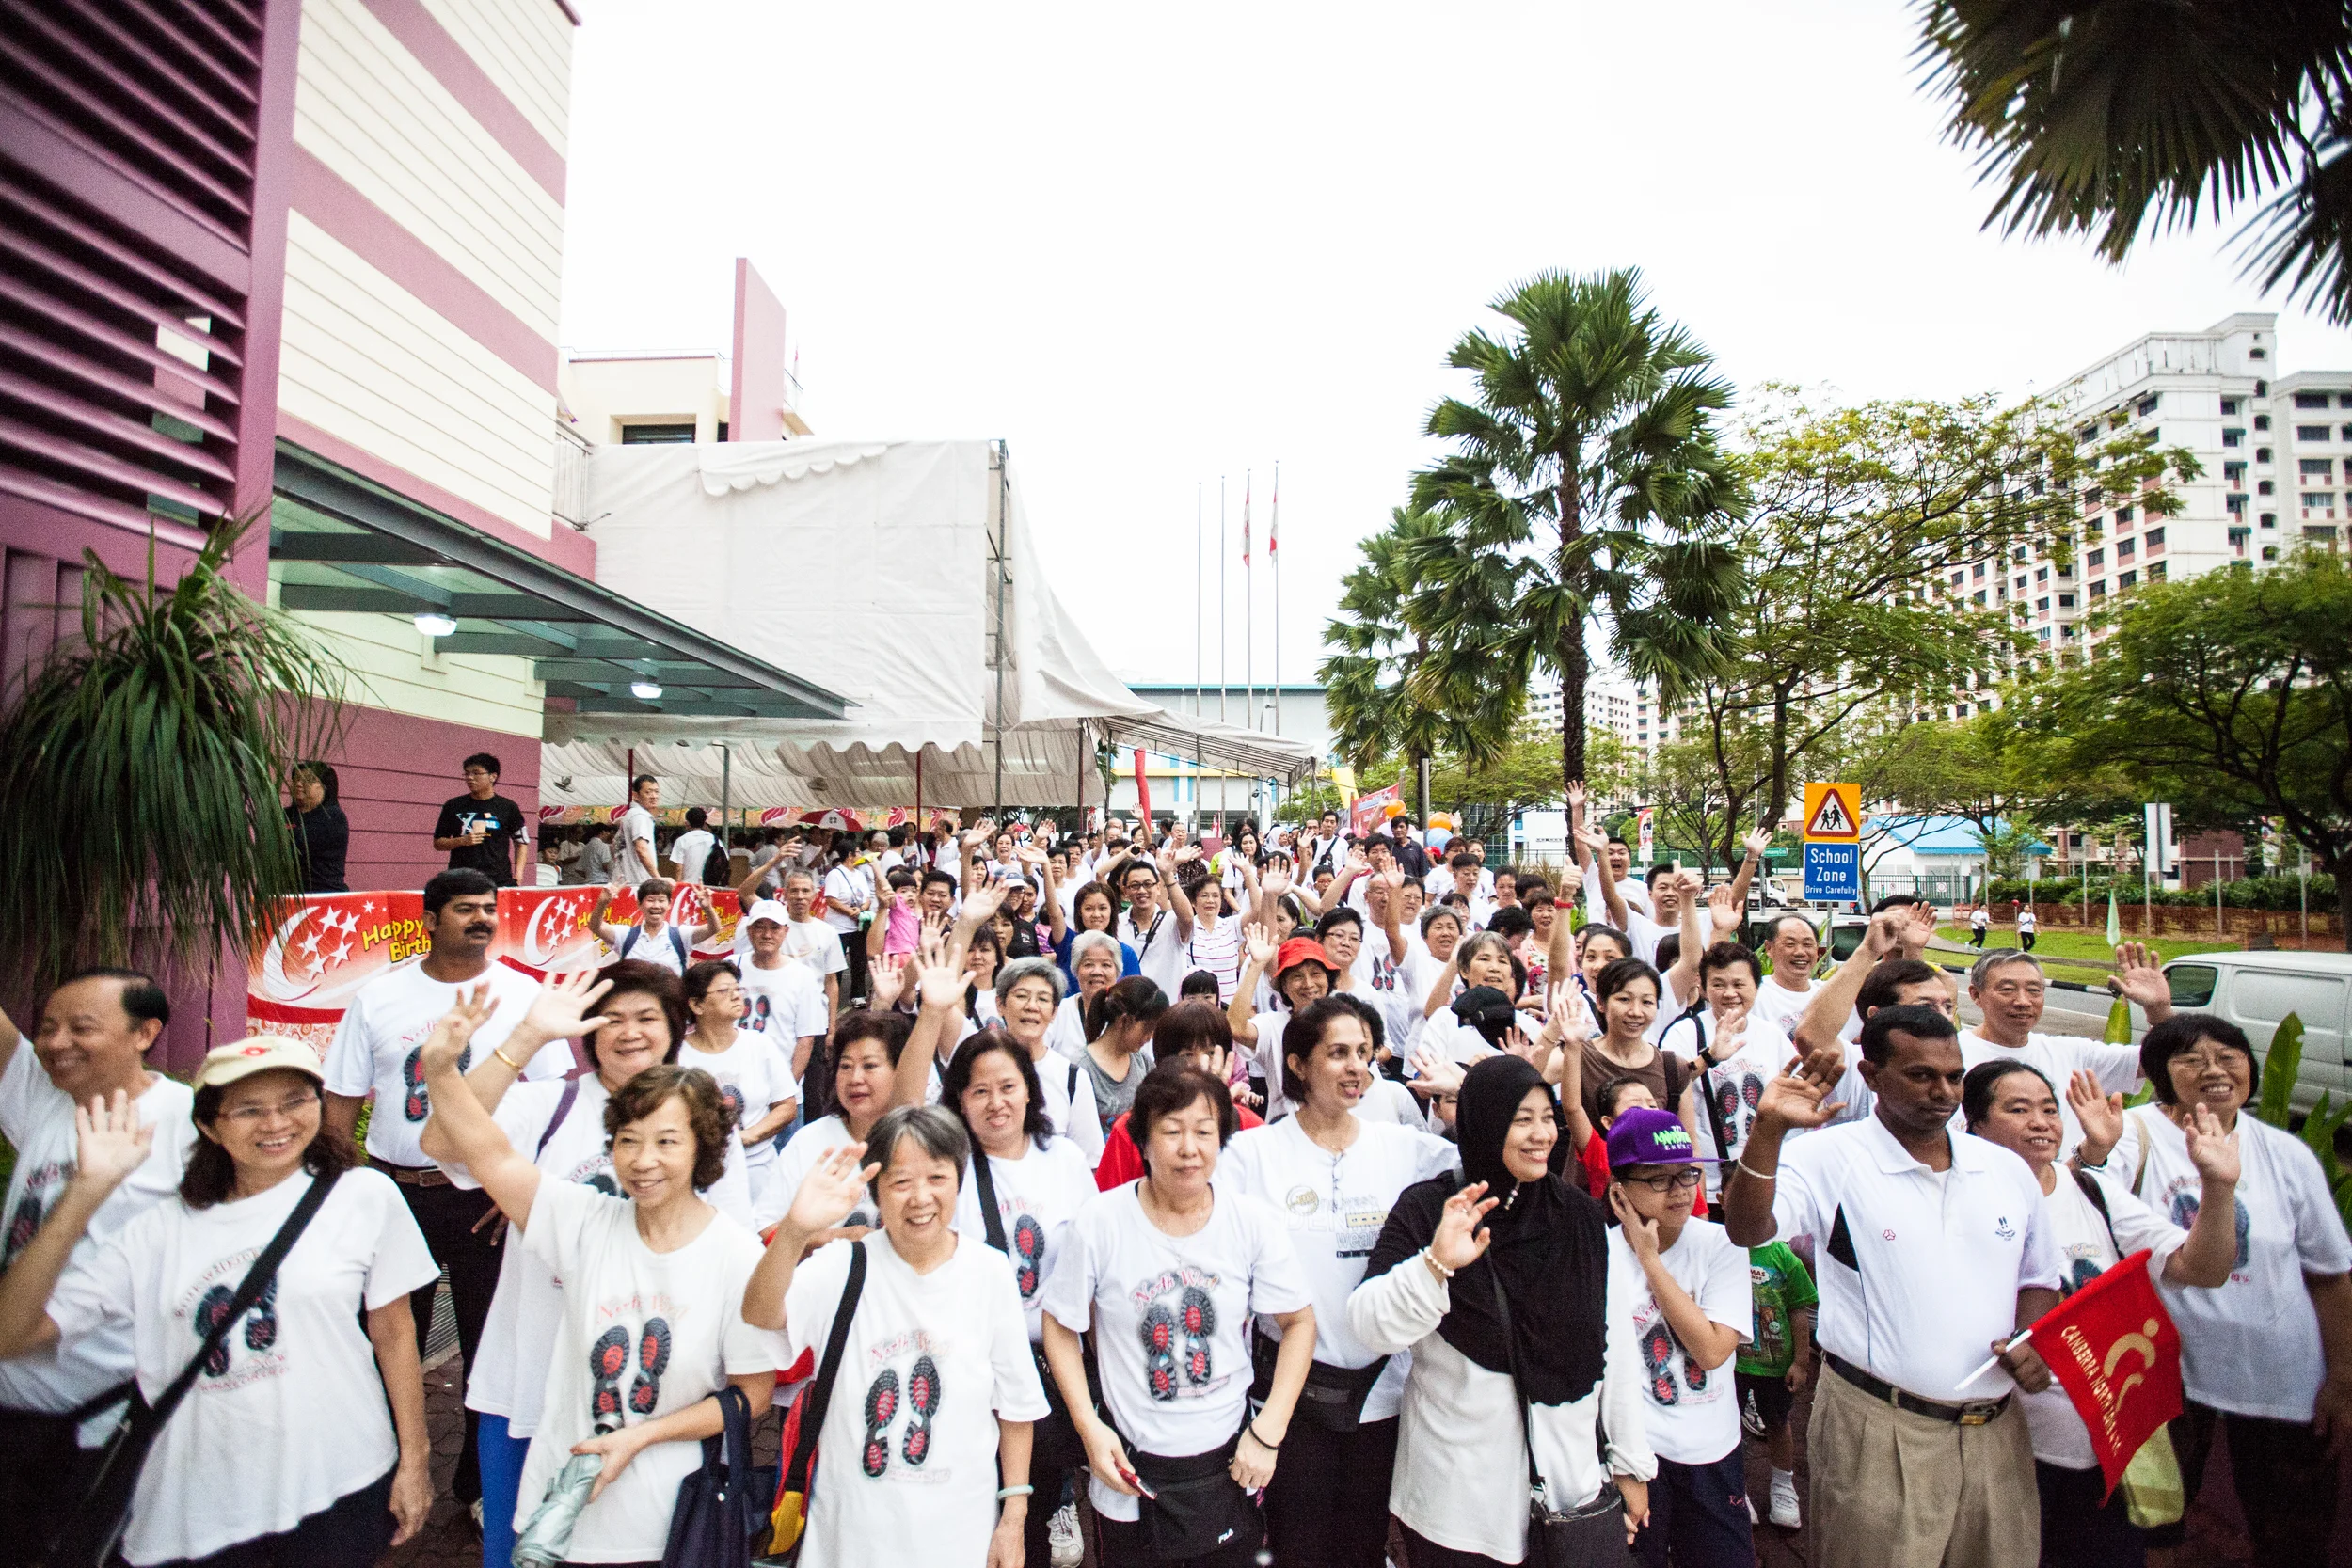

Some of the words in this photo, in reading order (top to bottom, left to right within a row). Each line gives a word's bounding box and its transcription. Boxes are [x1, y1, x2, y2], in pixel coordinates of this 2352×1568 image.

[1810, 848, 1853, 864] School
[1816, 866, 1847, 882] Zone
[1805, 885, 1823, 894] Drive
[1825, 885, 1856, 896] Carefully
[361, 918, 424, 952] Happy
[1133, 1272, 1176, 1312] North
[2060, 1325, 2100, 1380] CANBERRA
